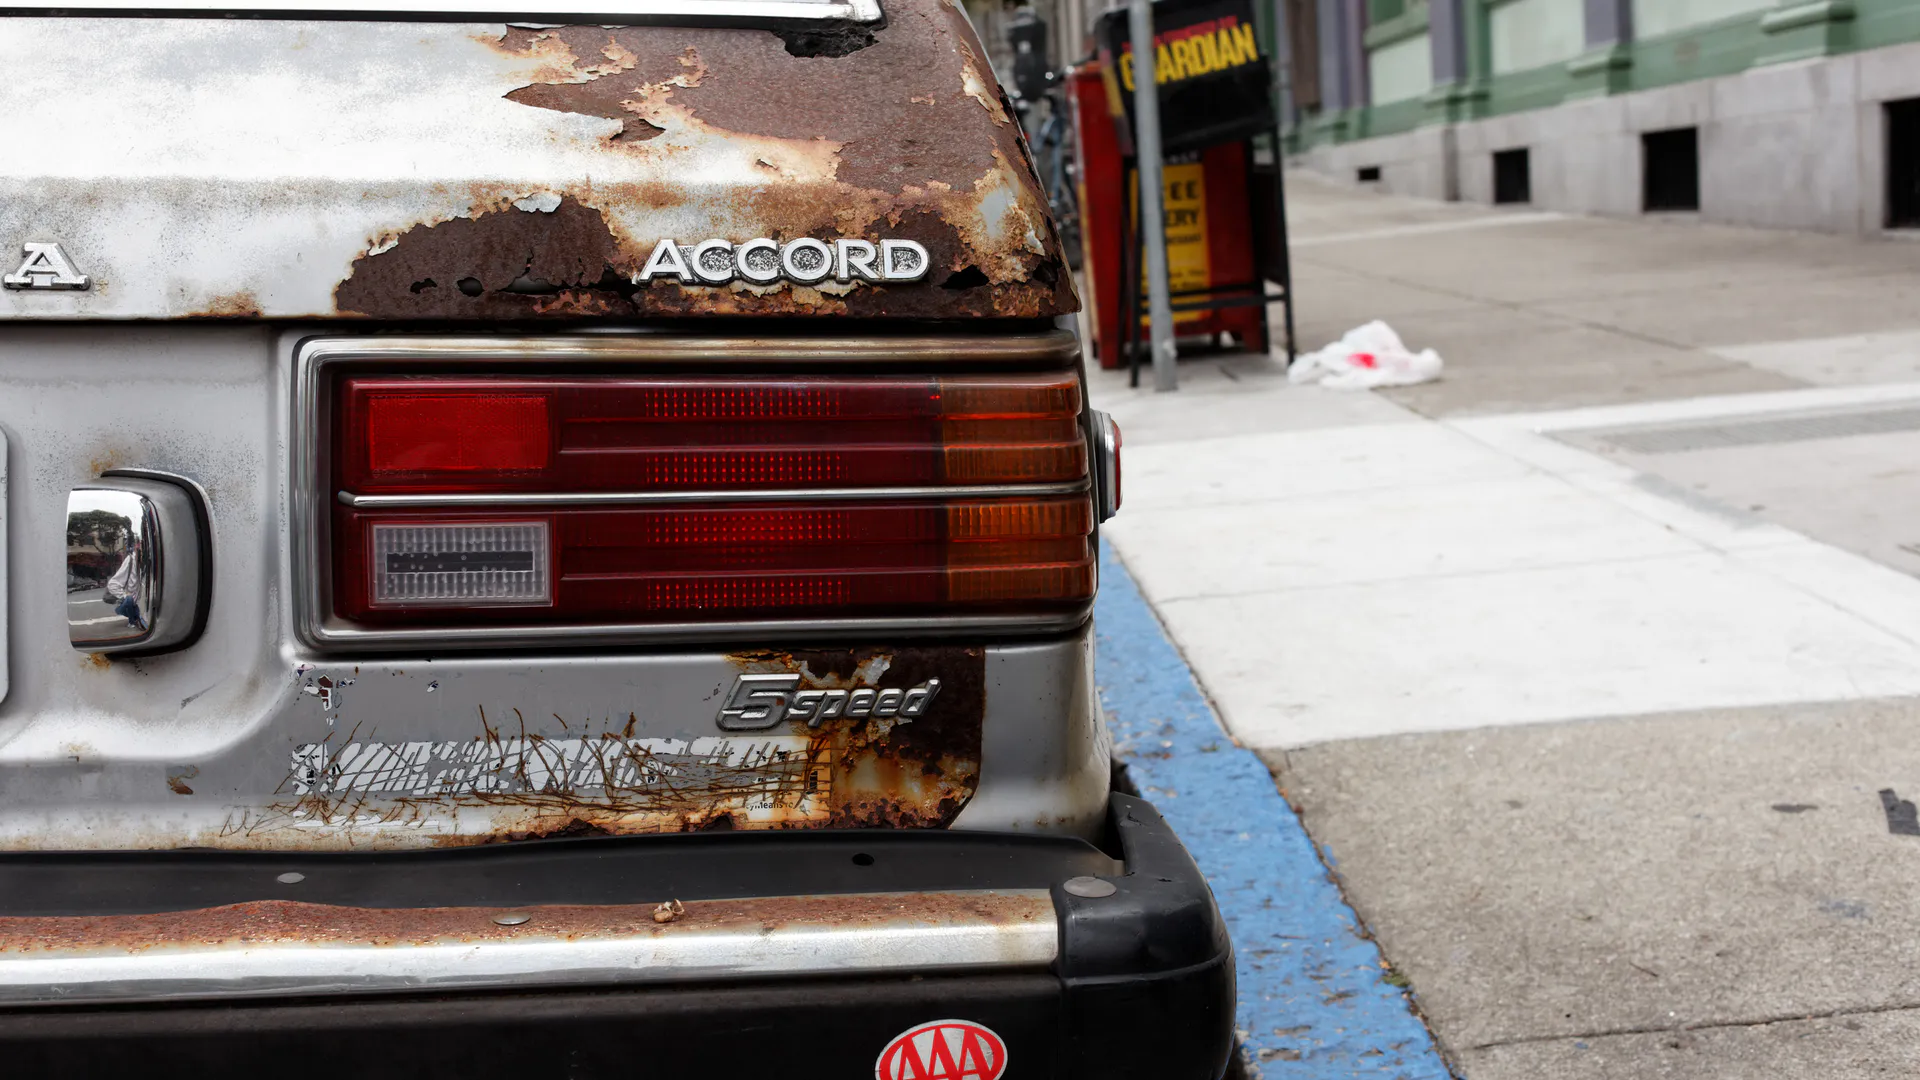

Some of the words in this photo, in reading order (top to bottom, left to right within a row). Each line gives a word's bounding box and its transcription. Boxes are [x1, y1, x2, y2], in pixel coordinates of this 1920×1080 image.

[1119, 22, 1258, 92] GARDIAN
[636, 238, 929, 285] ACCORD
[893, 1026, 998, 1080] AAA
